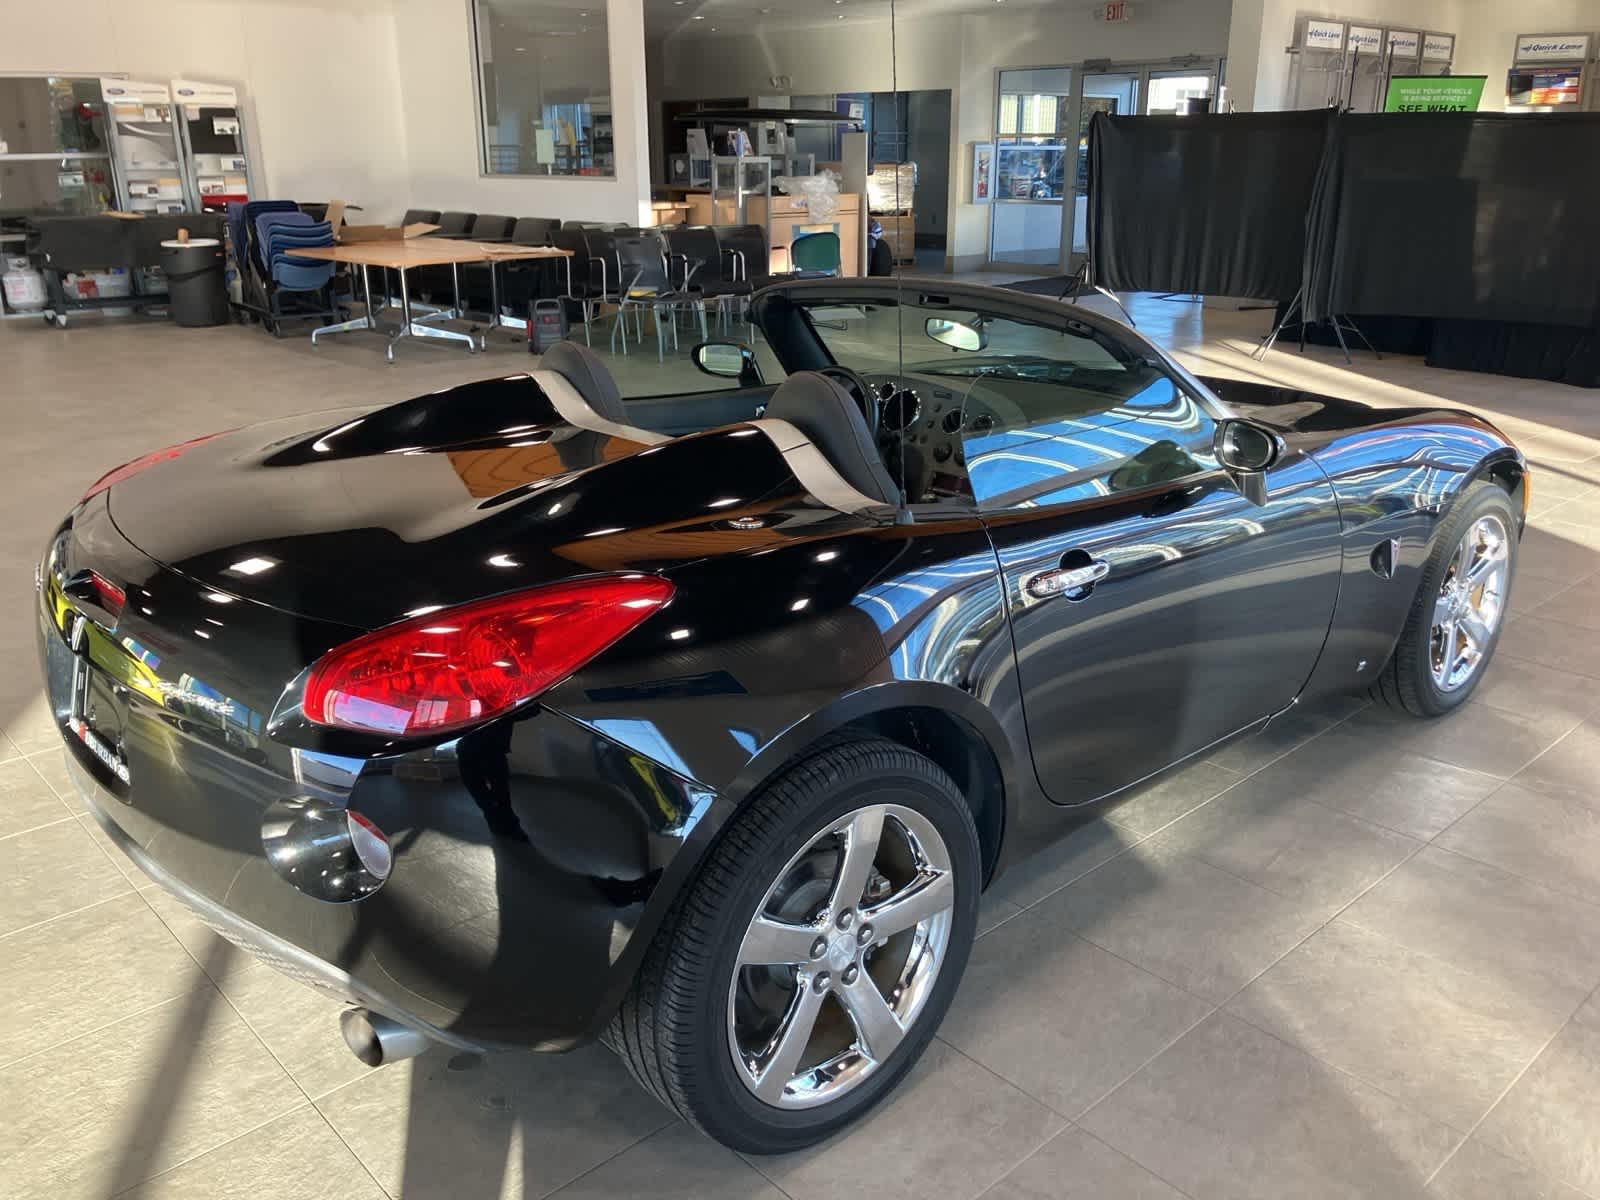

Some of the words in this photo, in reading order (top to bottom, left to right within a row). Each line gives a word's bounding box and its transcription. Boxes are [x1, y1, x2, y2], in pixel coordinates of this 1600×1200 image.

[1106, 3, 1124, 20] EXIT
[1313, 29, 1328, 38] Quick
[1328, 31, 1340, 39] Lane
[1355, 34, 1367, 44] Quick
[1367, 35, 1379, 44] Lane
[1532, 43, 1557, 51] Quick
[1398, 104, 1423, 112] SEE
[1427, 104, 1467, 112] WHAT
